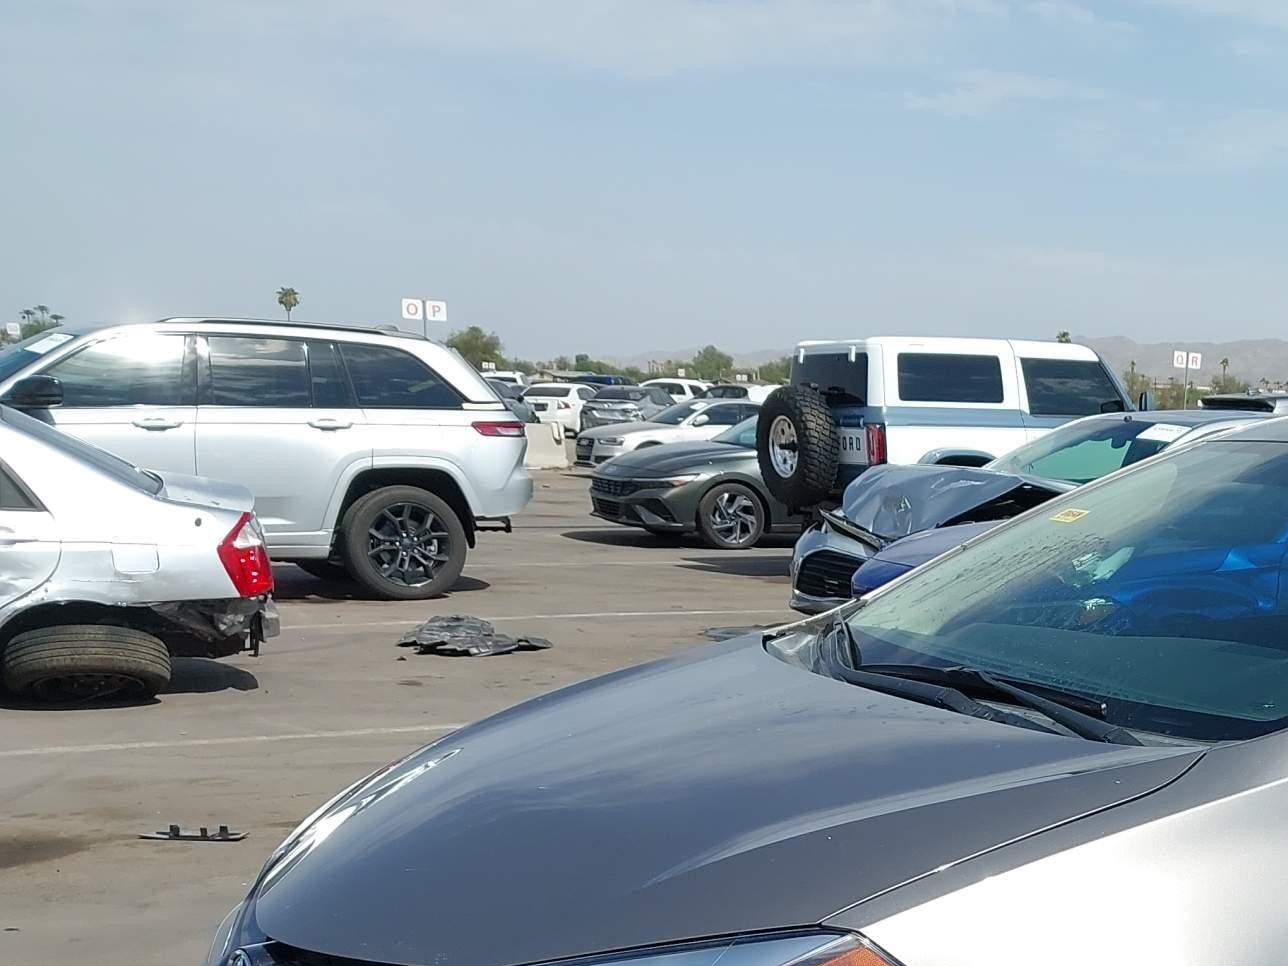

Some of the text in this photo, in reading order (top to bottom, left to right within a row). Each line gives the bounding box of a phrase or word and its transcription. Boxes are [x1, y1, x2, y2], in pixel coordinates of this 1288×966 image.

[406, 303, 441, 318] O P
[842, 436, 861, 451] ORD
